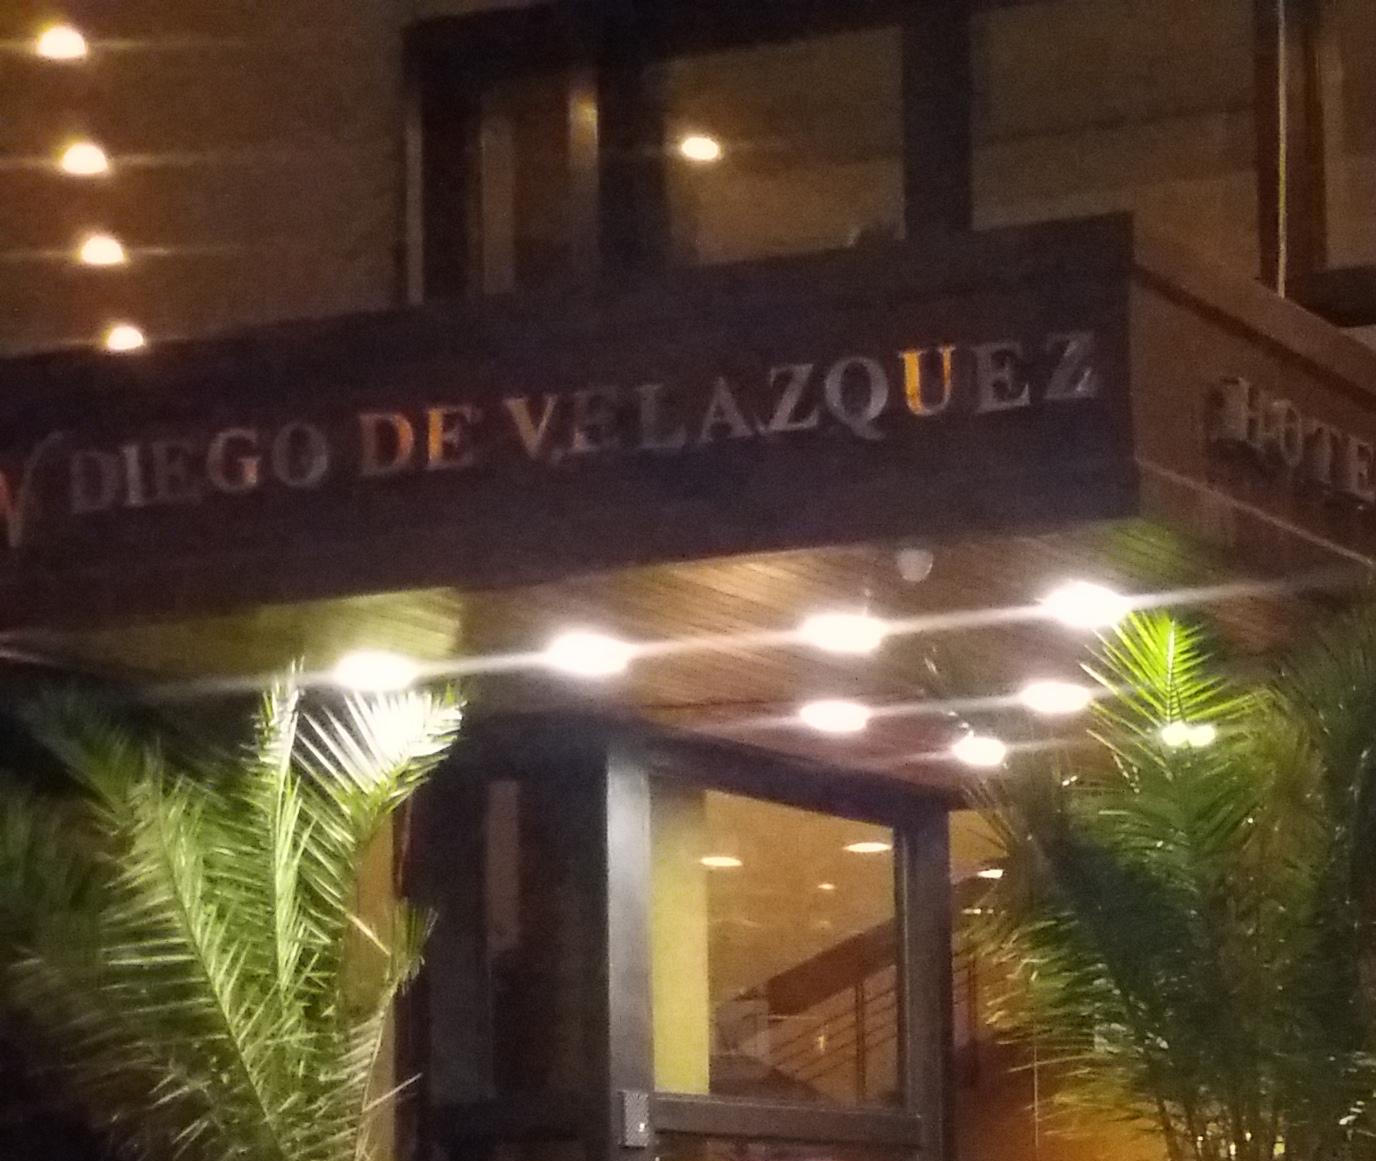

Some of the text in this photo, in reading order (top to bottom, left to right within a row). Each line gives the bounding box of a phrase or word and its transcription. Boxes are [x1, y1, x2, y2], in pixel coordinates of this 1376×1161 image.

[68, 422, 331, 515] DIEGO
[357, 404, 484, 478] DE
[506, 328, 1100, 466] VELAZQUEZ
